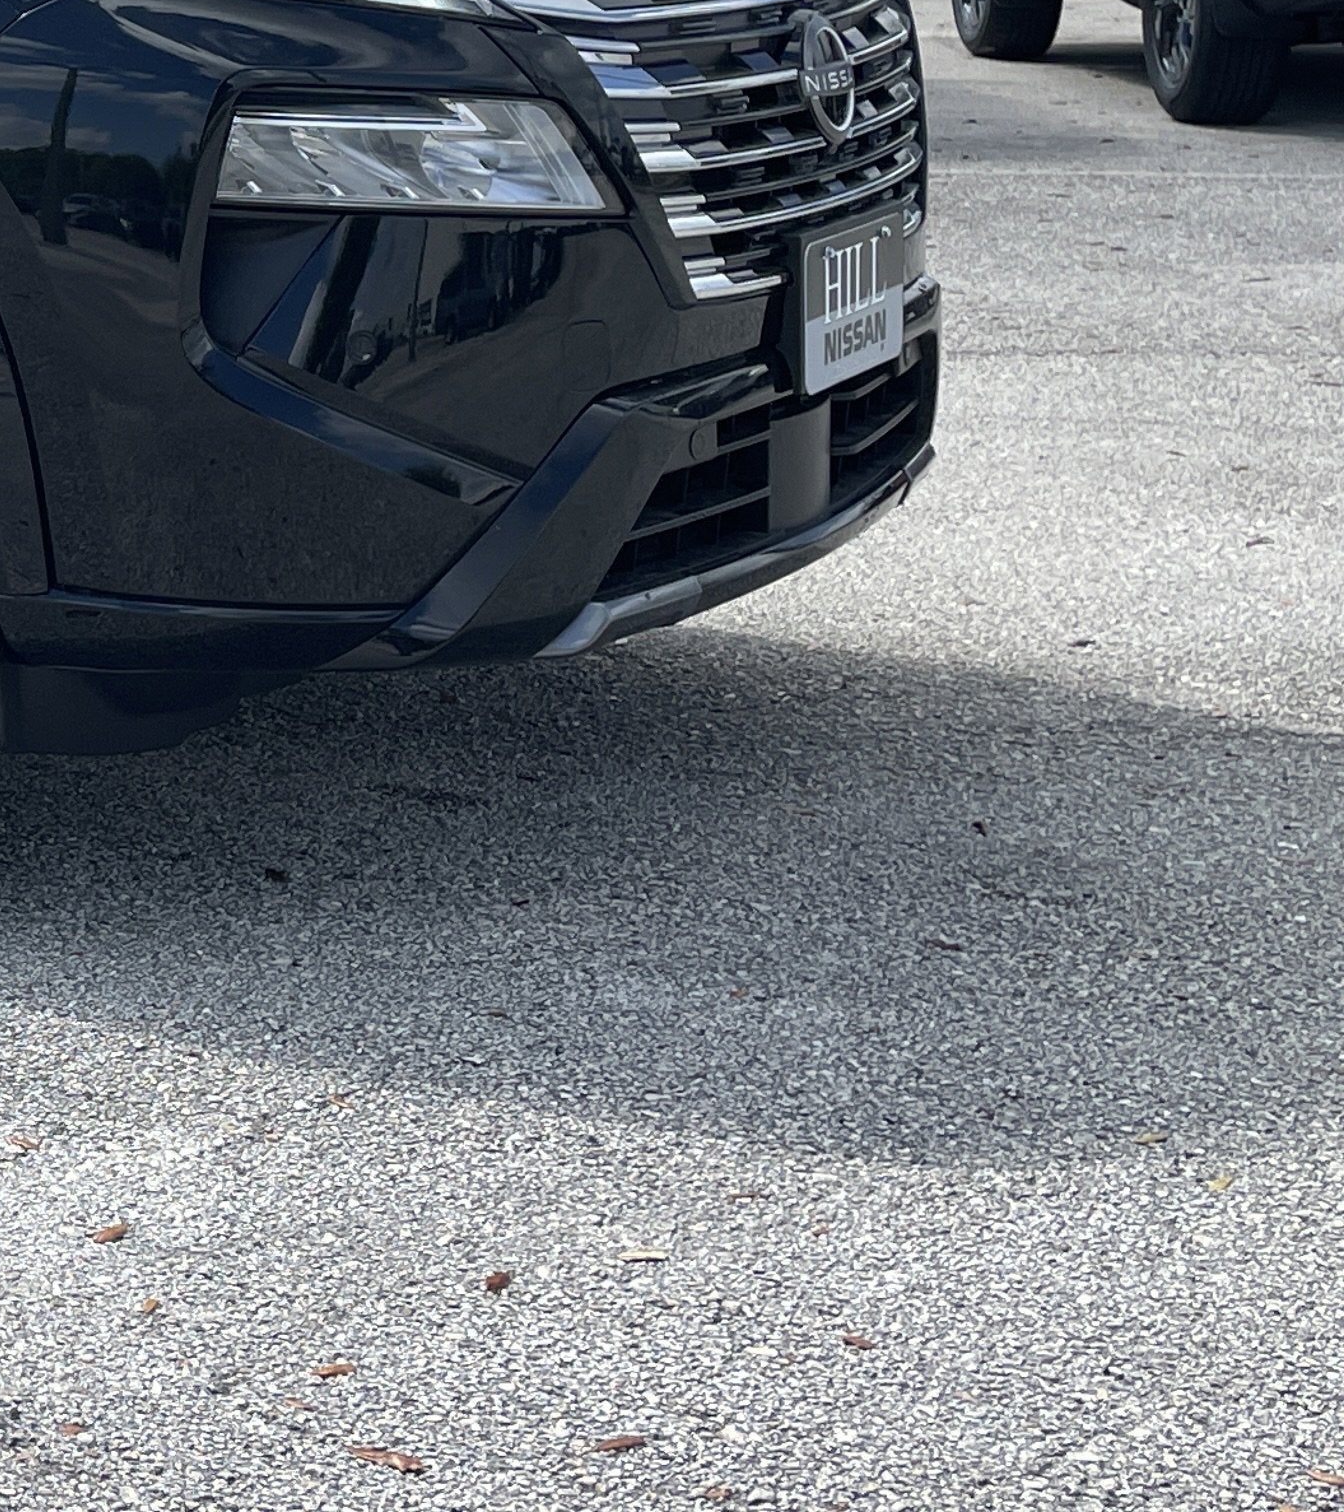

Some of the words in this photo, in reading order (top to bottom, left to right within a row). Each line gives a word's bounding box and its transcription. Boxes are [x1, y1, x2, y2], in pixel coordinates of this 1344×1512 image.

[804, 69, 853, 93] NISS
[822, 236, 888, 325] HILL
[823, 308, 887, 366] NISSAN
